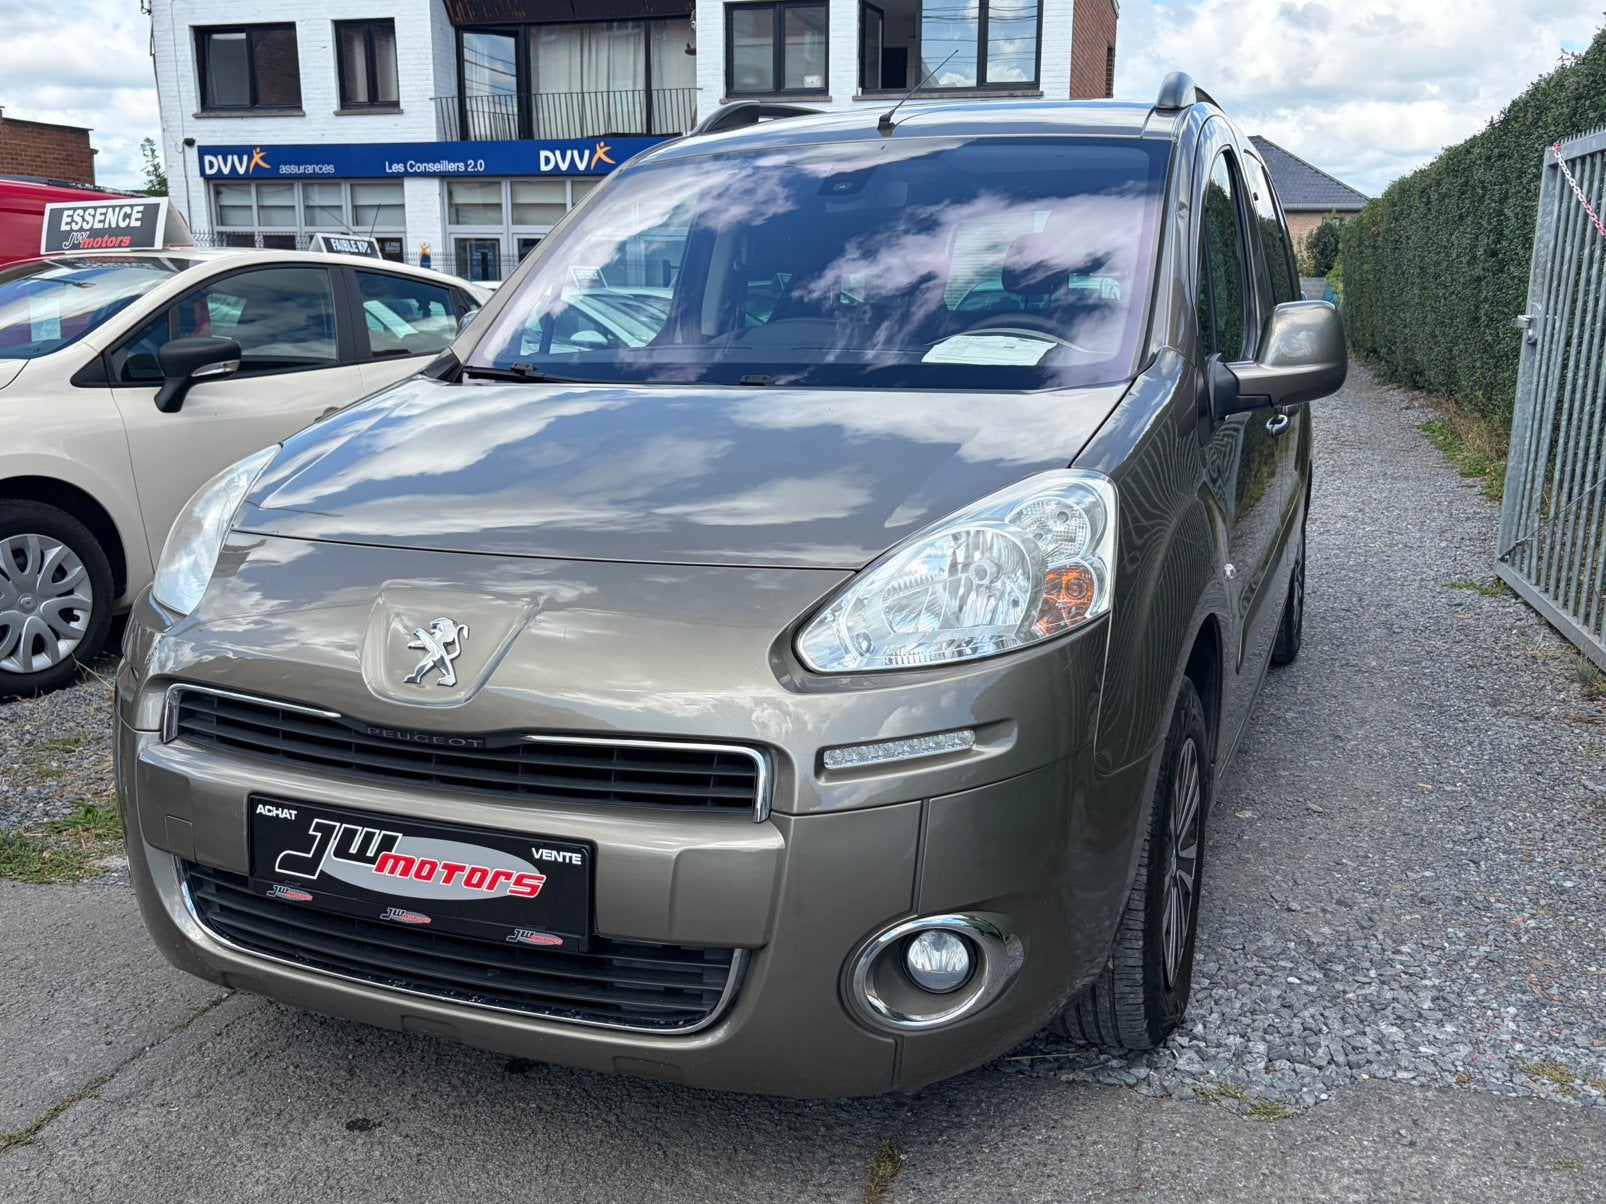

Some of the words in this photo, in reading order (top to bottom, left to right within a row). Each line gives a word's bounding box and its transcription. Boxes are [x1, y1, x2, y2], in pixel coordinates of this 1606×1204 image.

[203, 154, 248, 175] DVV
[279, 164, 335, 174] assurances
[385, 160, 405, 173] Les
[407, 159, 465, 173] Conseillers
[467, 159, 485, 172] 2.0
[539, 149, 590, 172] DVV
[60, 205, 145, 231] ESSENCE
[62, 231, 89, 249] JW
[80, 234, 132, 249] motors
[329, 238, 359, 254] FAIBLE
[367, 727, 484, 748] PEUGEOT
[256, 803, 298, 820] ACHAT
[531, 846, 582, 865] VENTE
